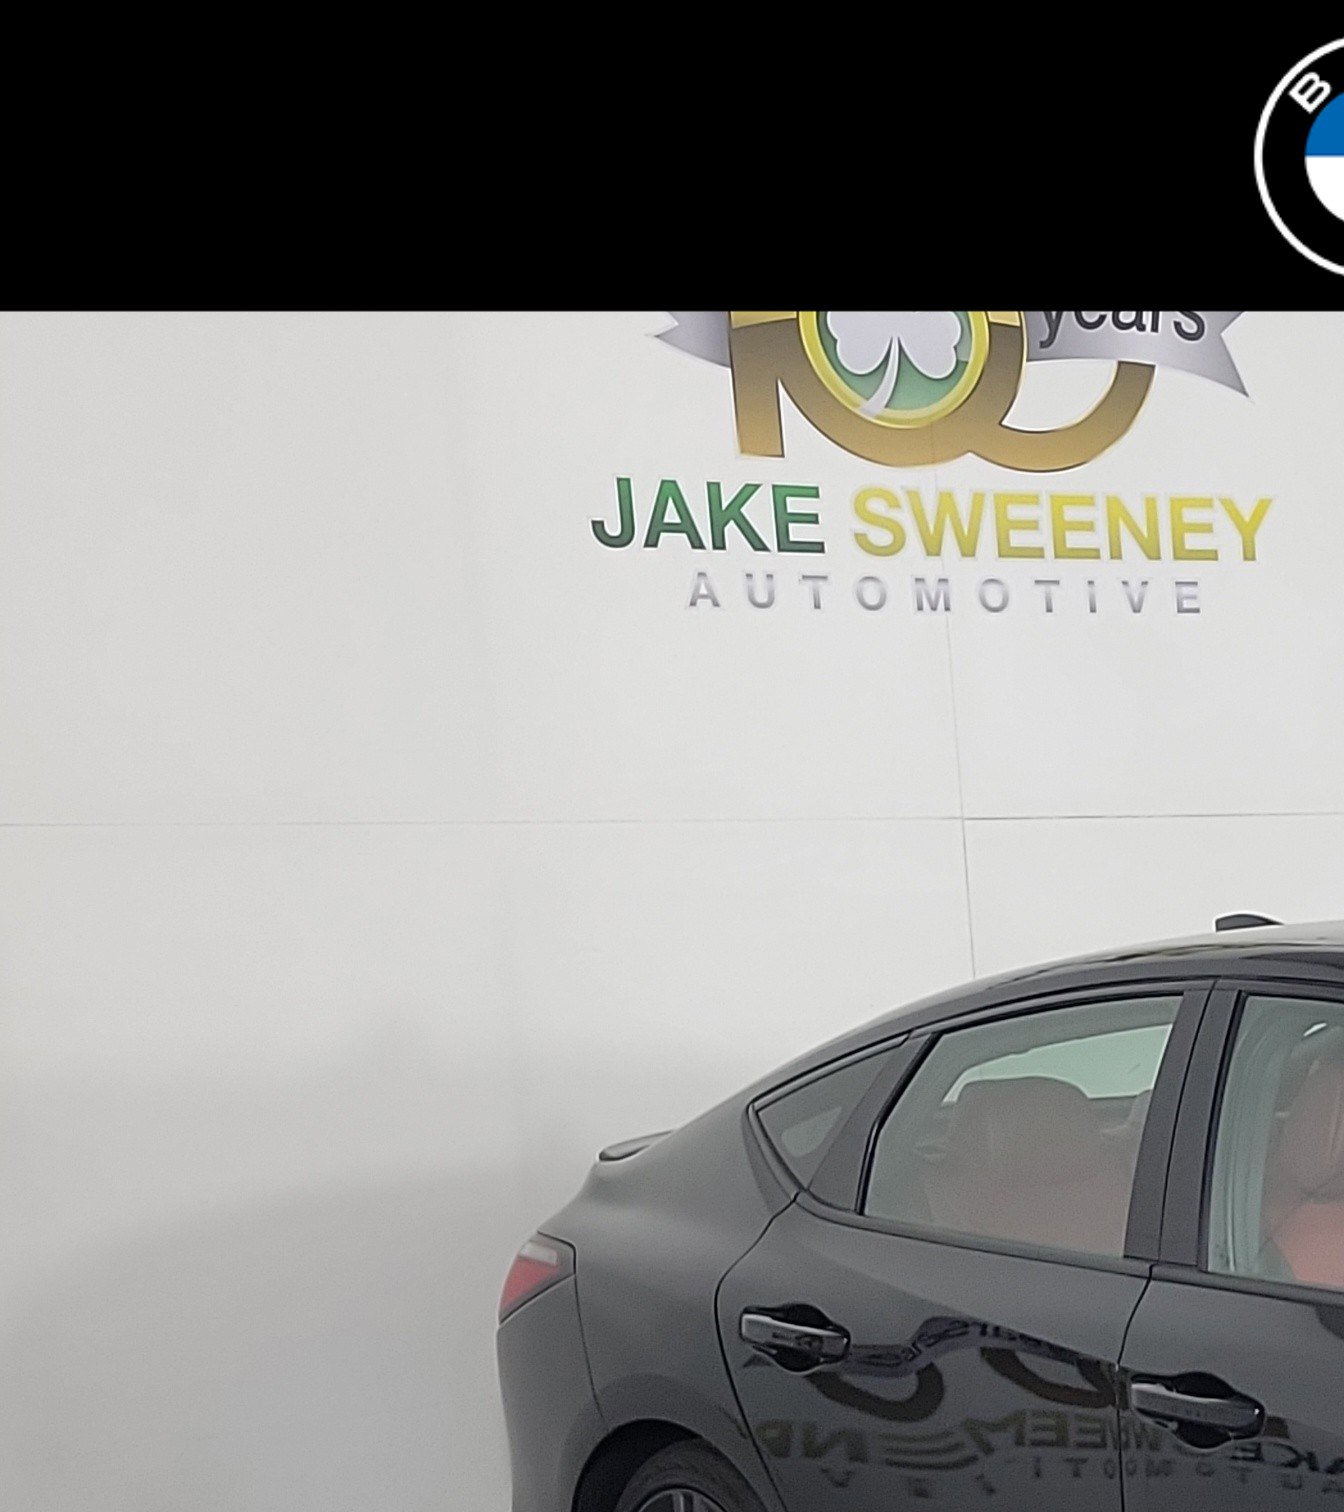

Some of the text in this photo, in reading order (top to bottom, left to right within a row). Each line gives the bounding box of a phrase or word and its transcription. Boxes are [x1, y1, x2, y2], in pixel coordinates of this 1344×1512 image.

[590, 476, 1273, 562] JAKE SWEENEY
[688, 571, 1202, 614] AUTOMOTIVE
